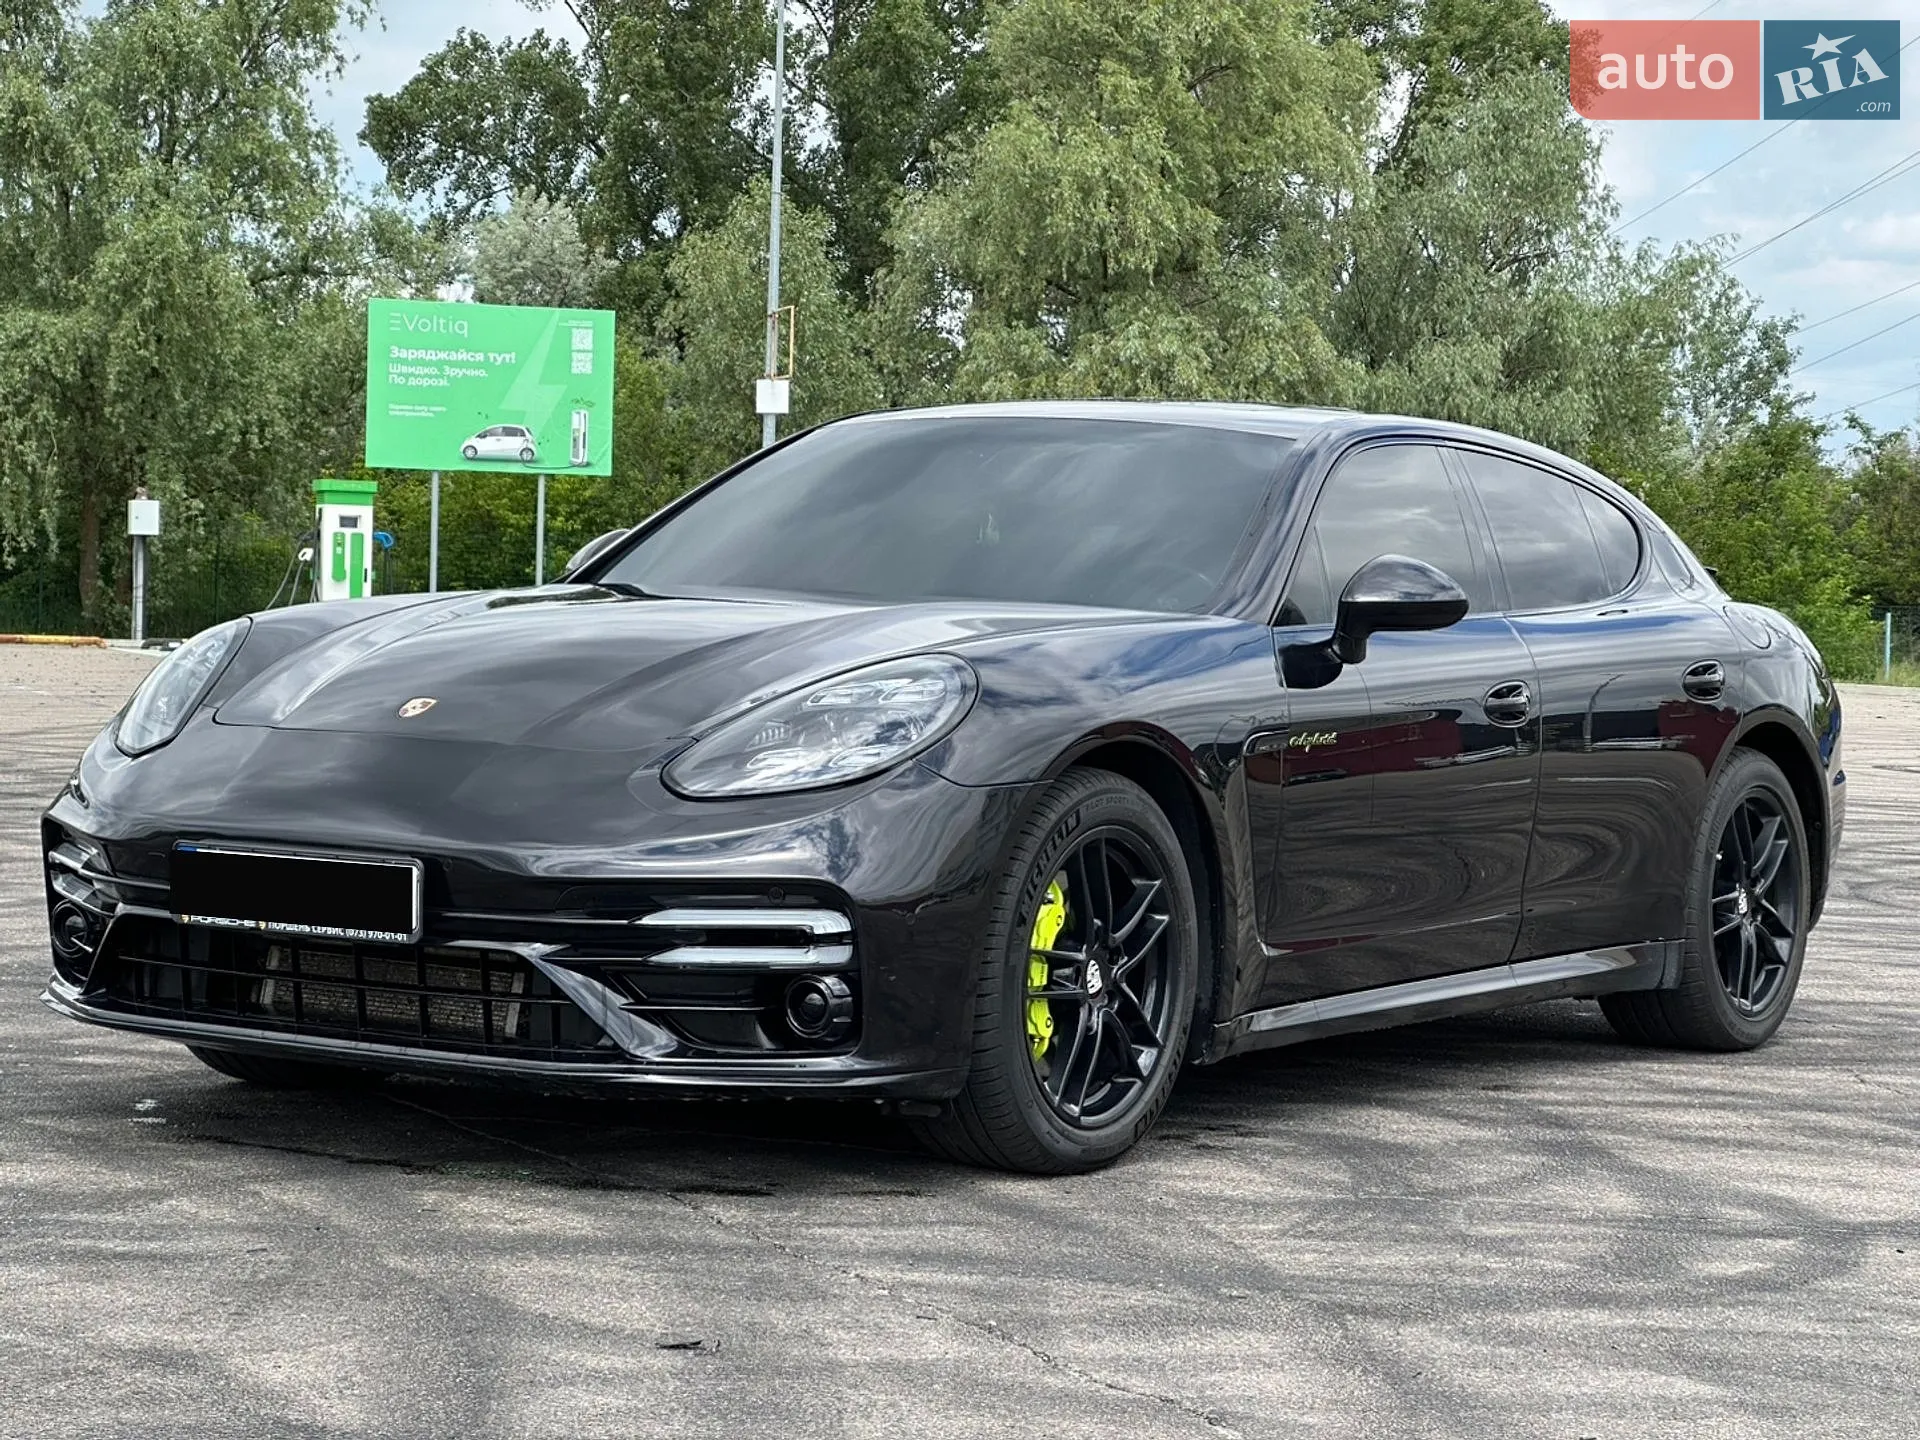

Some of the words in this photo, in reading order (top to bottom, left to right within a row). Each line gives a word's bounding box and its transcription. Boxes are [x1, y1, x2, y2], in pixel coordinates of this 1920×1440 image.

[389, 345, 485, 363] Заряджайся
[487, 351, 517, 366] тут!
[388, 363, 440, 376] Швидко.
[443, 365, 489, 378] Зручно.
[388, 374, 406, 386] По
[407, 376, 450, 388] дорозі.
